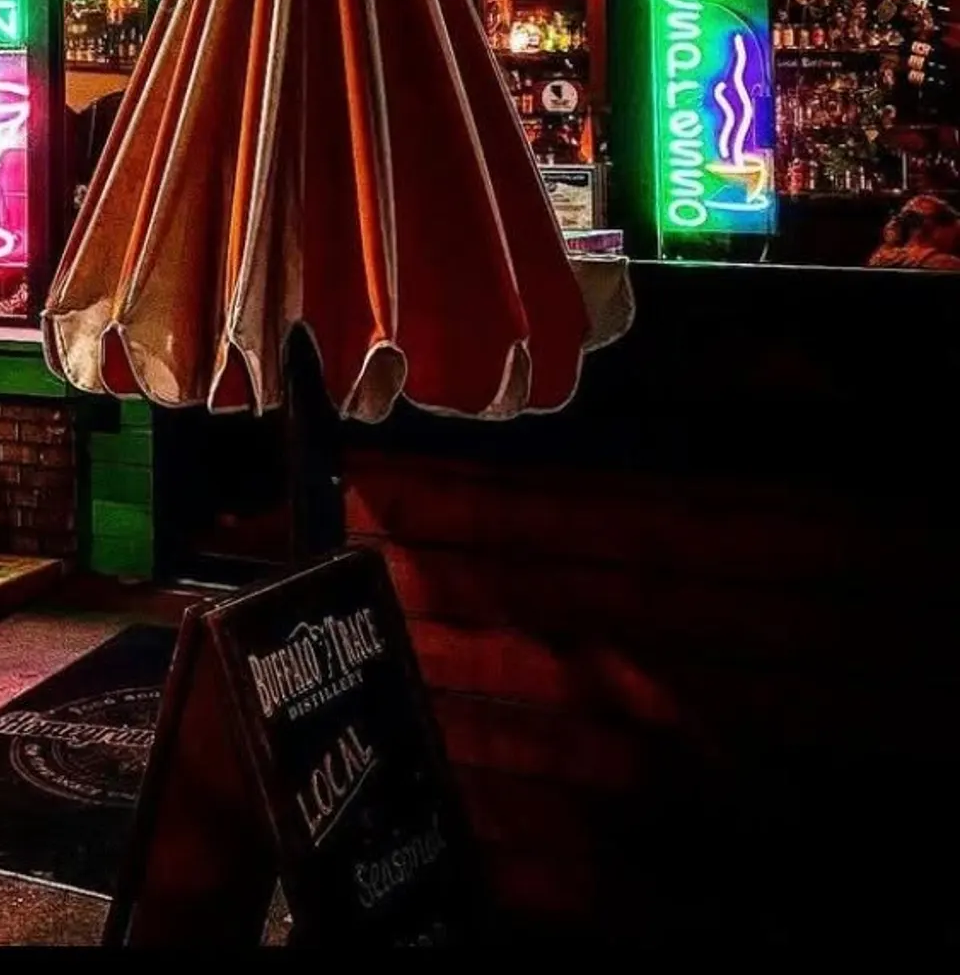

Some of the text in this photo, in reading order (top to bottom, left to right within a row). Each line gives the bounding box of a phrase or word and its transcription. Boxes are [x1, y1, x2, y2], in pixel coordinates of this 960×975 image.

[247, 608, 386, 718] BUFFALO TRACE
[288, 667, 364, 722] DISTILLERY
[295, 724, 374, 840] LOCAL
